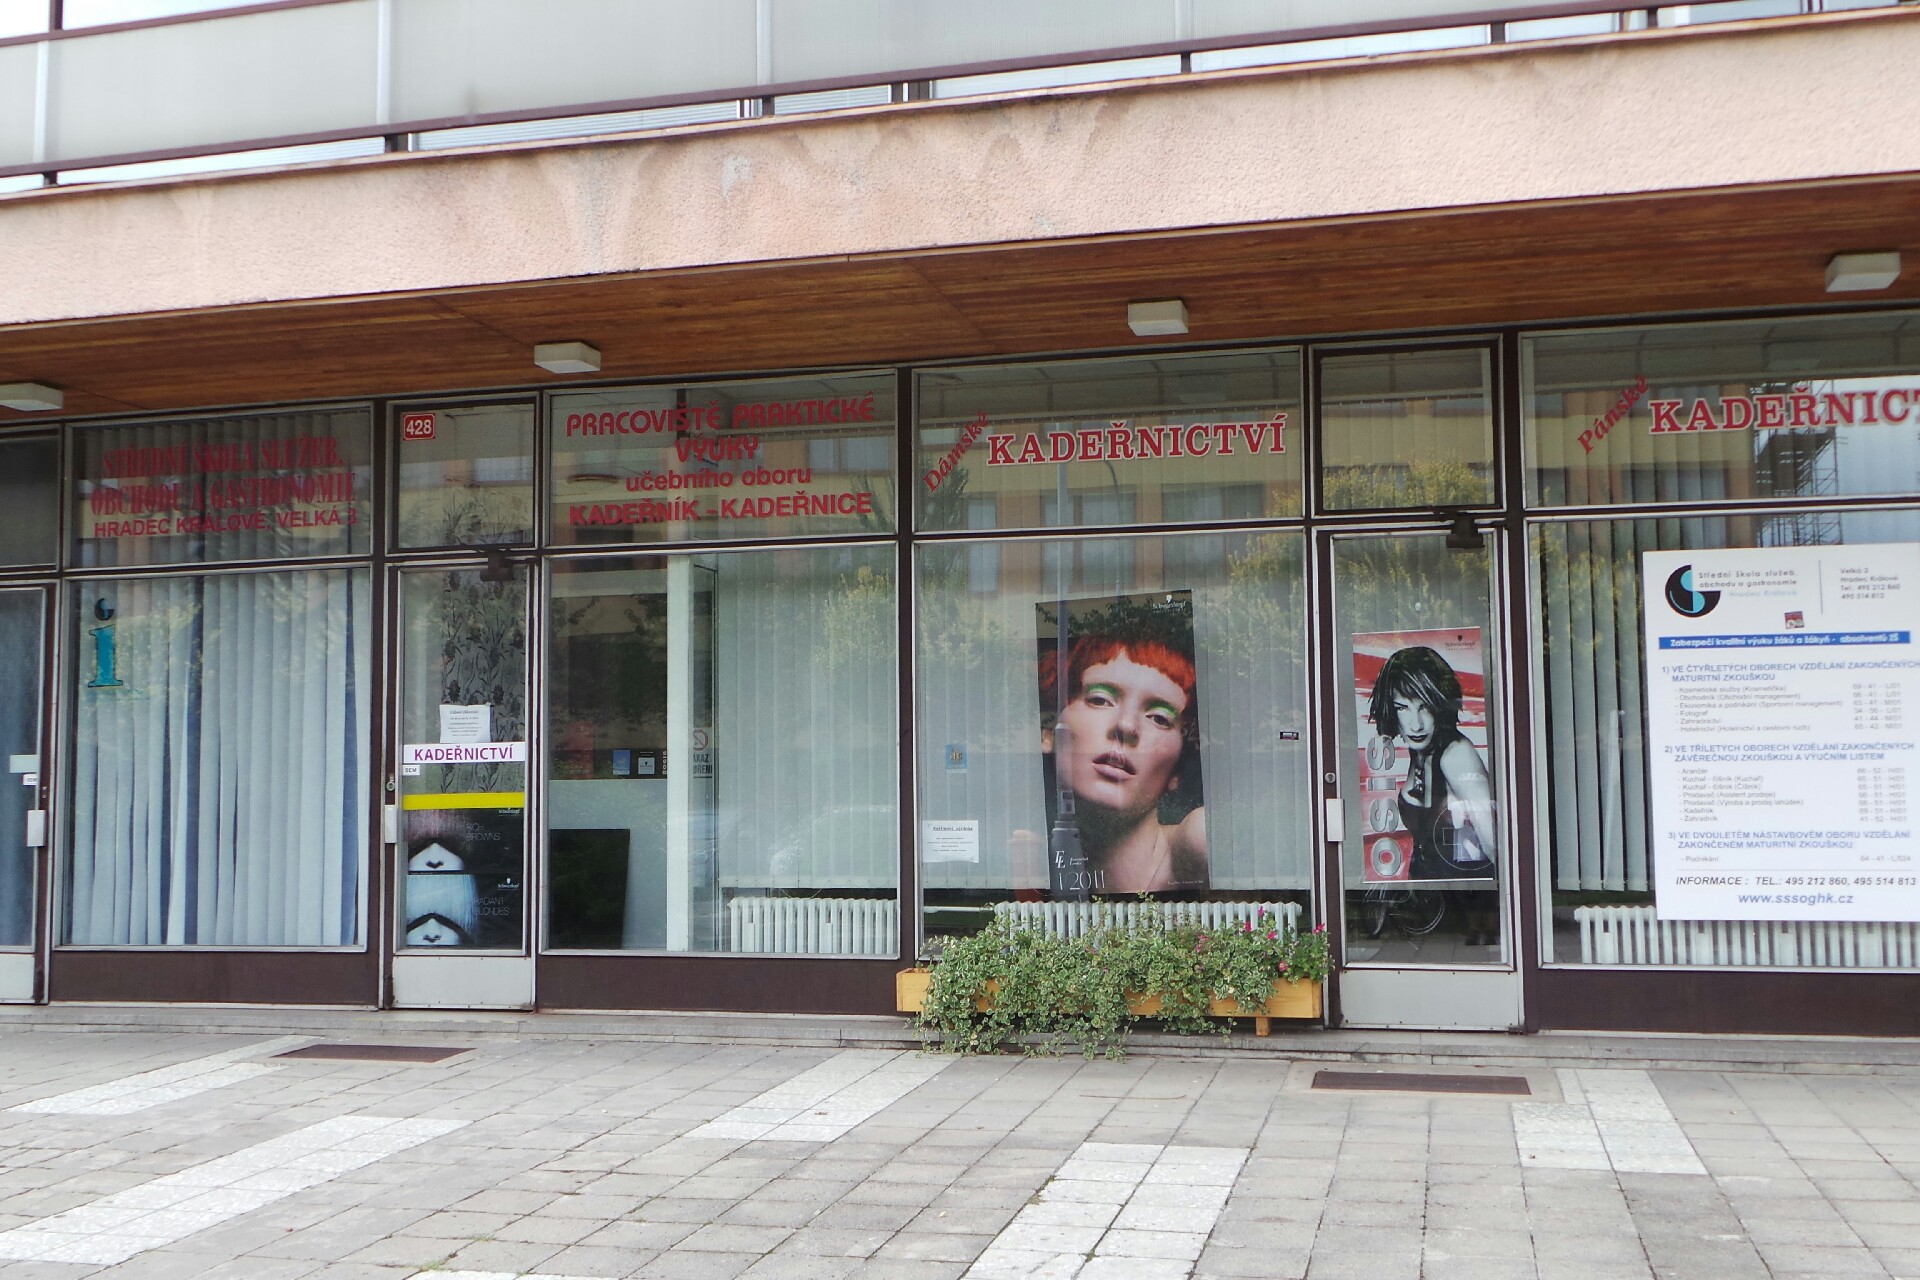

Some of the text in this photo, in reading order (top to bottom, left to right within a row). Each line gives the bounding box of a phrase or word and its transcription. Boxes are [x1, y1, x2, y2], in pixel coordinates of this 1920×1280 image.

[566, 391, 874, 437] PRACOVIŠTĚ PRAKTICKÉ
[1577, 374, 1920, 455] Pánské KADEŘNIC
[407, 419, 432, 435] 428
[675, 433, 759, 462] VÝUKY
[923, 409, 1288, 493] Dámské KADEŘNICTVÍ
[625, 465, 811, 492] učebního oboru
[90, 473, 357, 516] OBCHODU A GASTRONOMIE
[569, 497, 700, 526] KADEŘNÍK
[721, 491, 873, 519] KADEŘNICE
[94, 518, 170, 537] HRADEC
[176, 511, 271, 534] KRÁLOVÉ,
[277, 505, 341, 528] VELKÁ
[1686, 662, 1747, 672] ČTYŘLETÝCH
[1749, 662, 1796, 671] OBORECH
[1672, 672, 1775, 682] MATURITNÍ ZKOUŠKOU
[414, 744, 514, 761] KADEŘNICTVÍ
[1741, 752, 1793, 761] ZKOUŠKOU
[1743, 744, 1790, 752] OBORECH
[1692, 830, 1750, 839] DVOULETÉM
[1753, 829, 1823, 838] NÁSTAVBOVÉM
[1678, 839, 1853, 849] ZAKONČENÉM MATURITNÍ ZKOUŠKOU
[1068, 869, 1105, 891] 2011
[1676, 877, 1742, 886] INFORMACE
[1785, 877, 1804, 886] 495
[1807, 877, 1826, 886] 212
[1829, 877, 1850, 887] 860,
[1853, 877, 1872, 886] 495
[1875, 877, 1894, 886] 514
[1897, 877, 1917, 886] 813
[1738, 892, 1854, 906] www.sssoghk.cz
